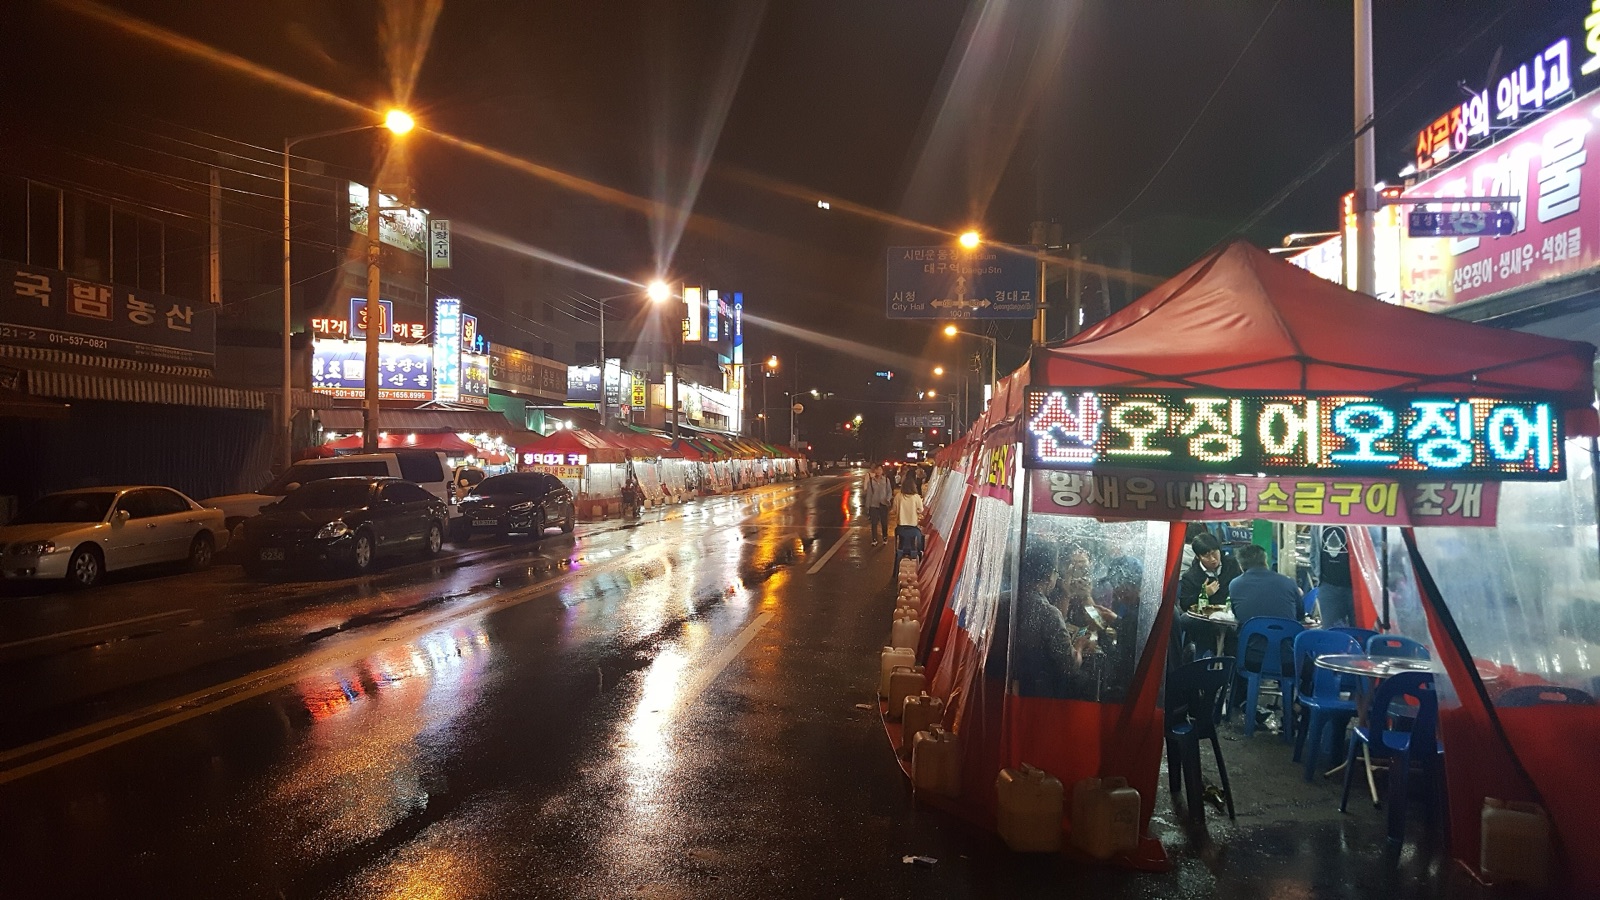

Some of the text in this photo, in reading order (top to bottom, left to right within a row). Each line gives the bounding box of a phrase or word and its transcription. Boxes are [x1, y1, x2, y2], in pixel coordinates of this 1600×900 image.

[1496, 37, 1571, 121] 아나고
[903, 249, 959, 261] 시민운동장
[924, 262, 960, 274] 대구역
[988, 266, 1002, 274] Stn
[892, 291, 916, 302] 시청
[995, 290, 1031, 302] 경대교
[891, 303, 908, 312] City
[49, 333, 108, 349] 011-537-0821
[378, 372, 429, 387] 산물
[1049, 470, 1156, 508] 왕새우
[1258, 481, 1399, 517] 소금구이
[1411, 482, 1483, 518] 조개
